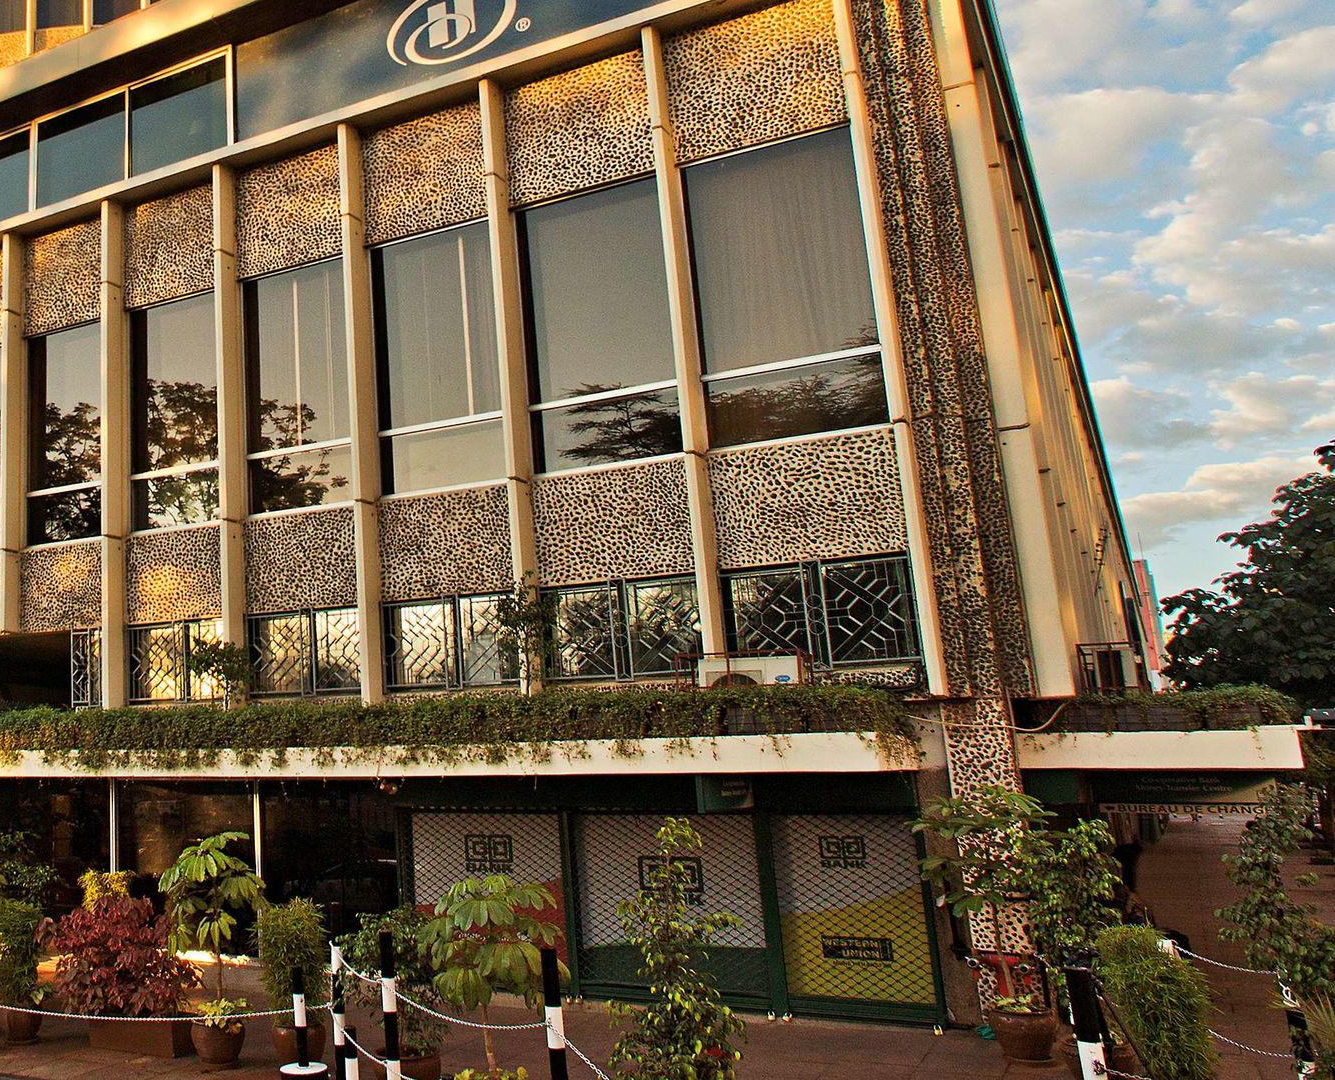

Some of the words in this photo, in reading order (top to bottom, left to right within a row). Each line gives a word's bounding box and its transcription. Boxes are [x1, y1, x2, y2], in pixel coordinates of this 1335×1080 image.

[1118, 805, 1179, 813] BUREAU
[1184, 805, 1202, 814] DE
[1208, 805, 1268, 814] CHANG
[465, 862, 513, 873] BANK
[821, 860, 868, 869] BANK
[822, 937, 878, 947] WESTERN
[842, 949, 880, 959] UNION
